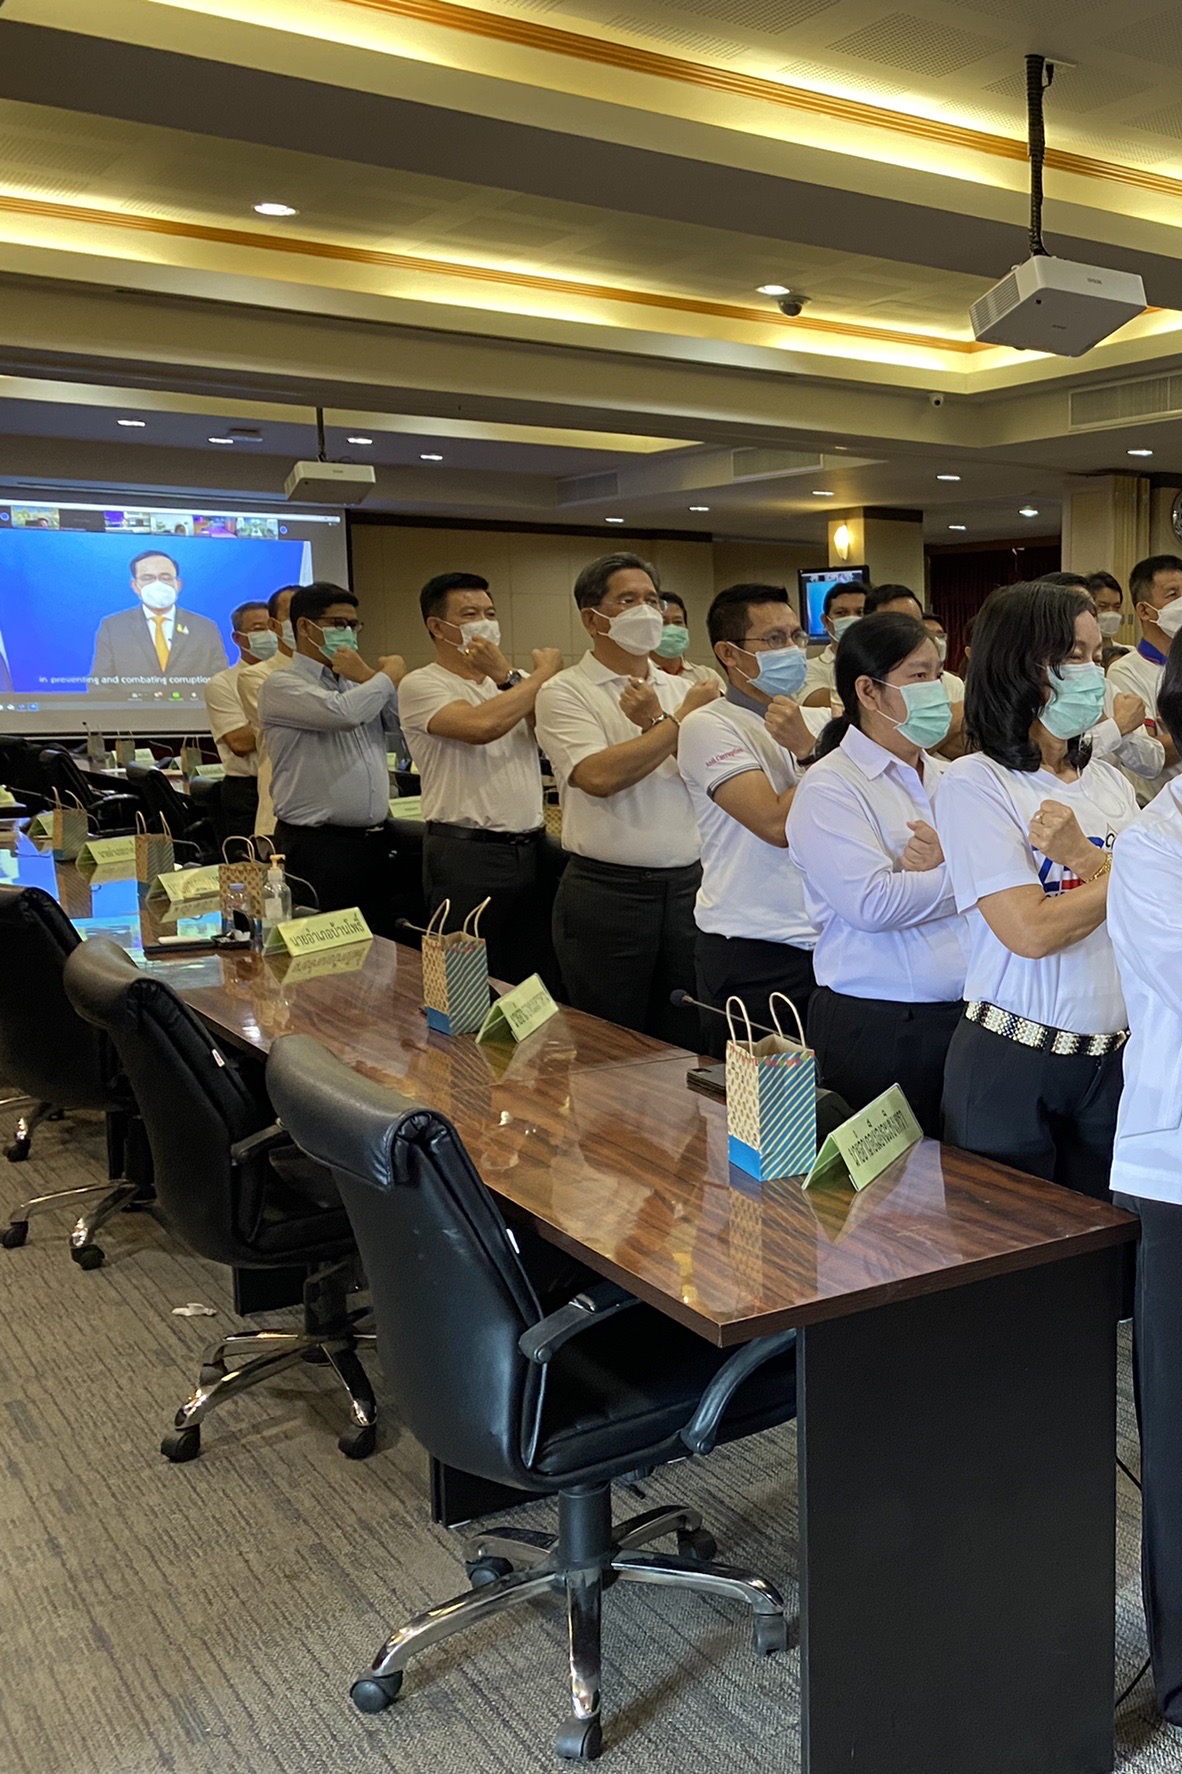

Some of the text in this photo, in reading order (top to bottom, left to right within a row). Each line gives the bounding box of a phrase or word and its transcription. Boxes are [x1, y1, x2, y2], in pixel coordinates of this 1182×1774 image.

[50, 676, 98, 685] preventing
[121, 676, 168, 685] combating
[289, 912, 365, 948] นายอำเภอบ้านโพธิ์
